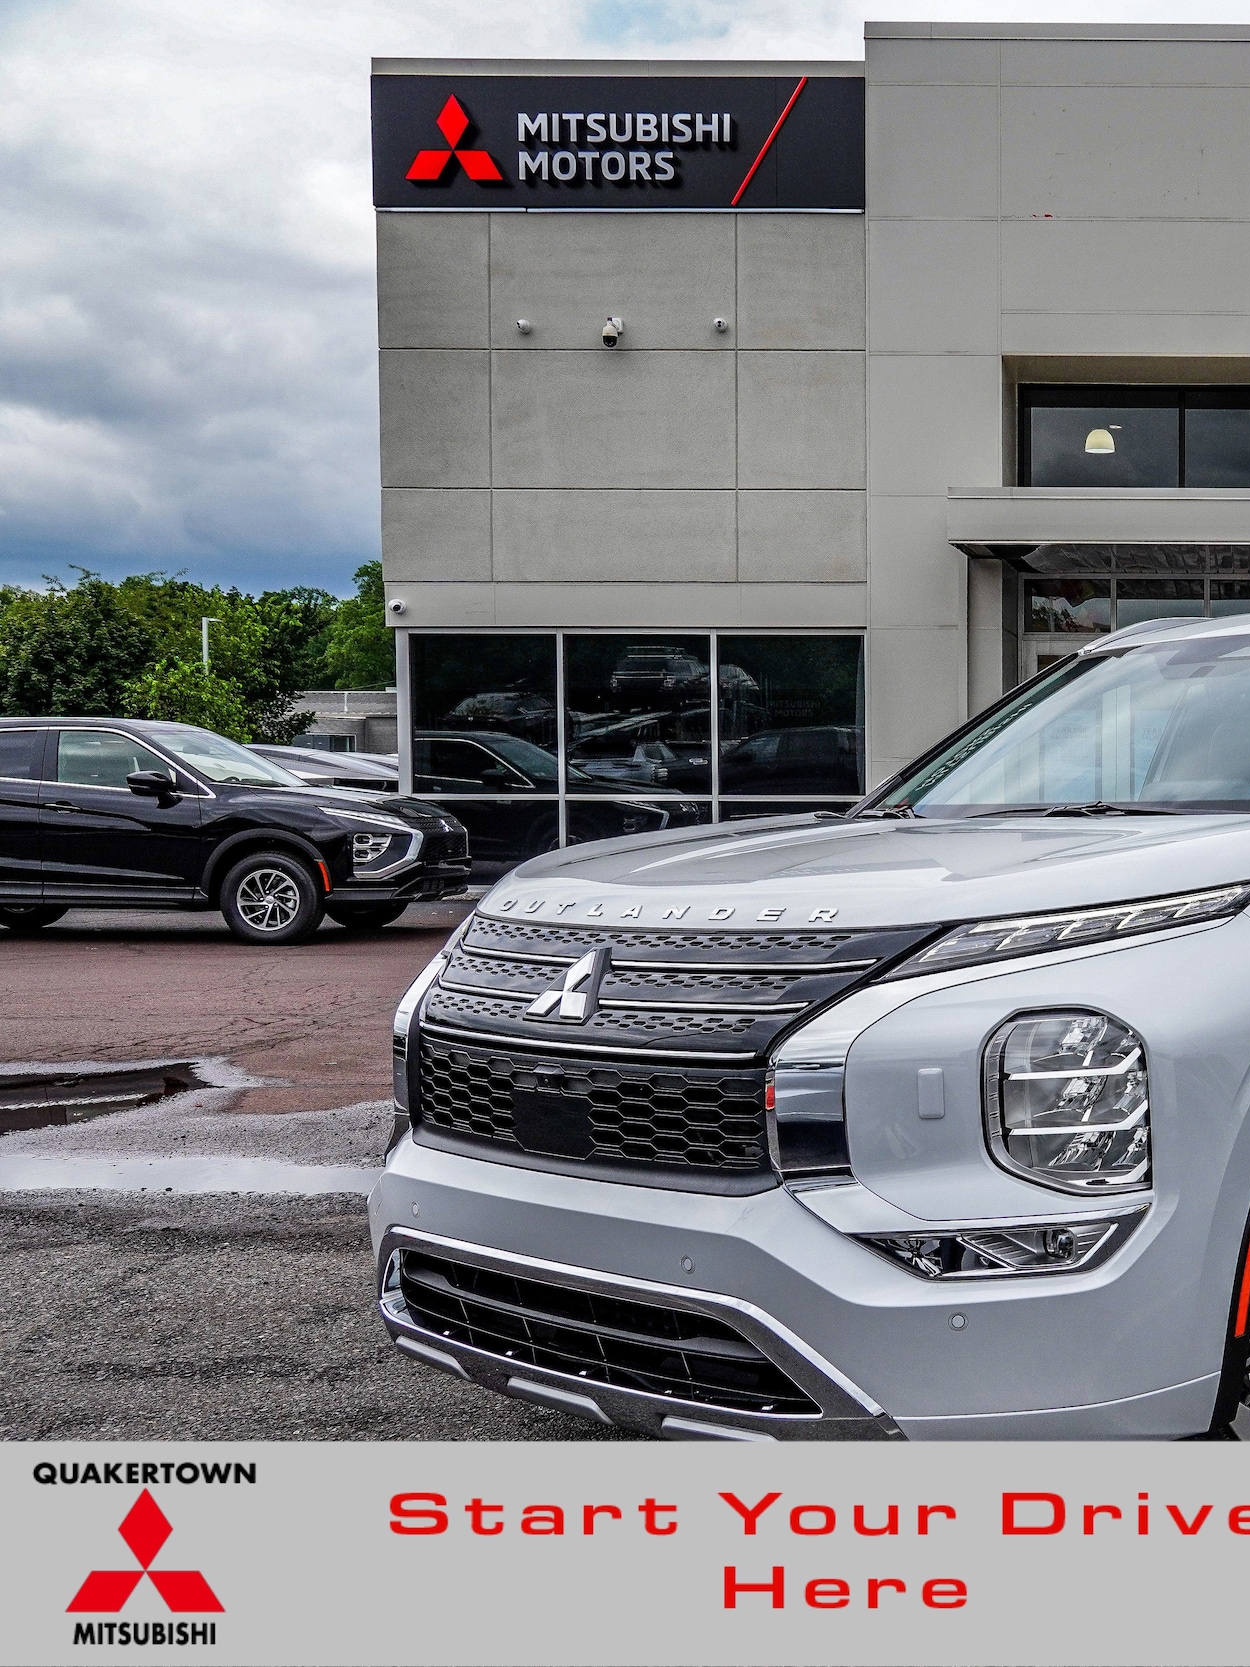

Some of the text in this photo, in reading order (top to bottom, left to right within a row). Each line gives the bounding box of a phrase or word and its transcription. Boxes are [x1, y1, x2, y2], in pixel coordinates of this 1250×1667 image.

[517, 111, 732, 145] MITSUBISHI
[517, 149, 676, 182] MOTORS
[774, 709, 814, 717] MOTORS
[498, 898, 840, 924] OUTLANDER
